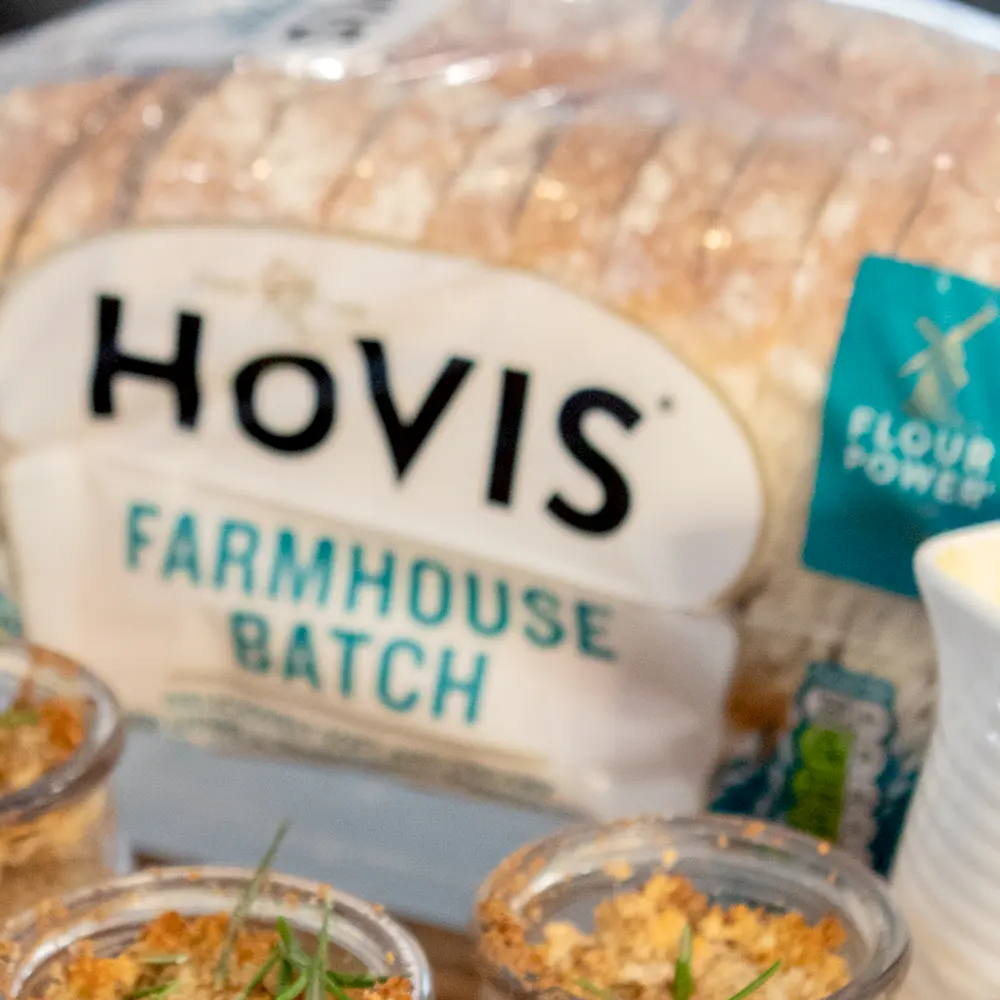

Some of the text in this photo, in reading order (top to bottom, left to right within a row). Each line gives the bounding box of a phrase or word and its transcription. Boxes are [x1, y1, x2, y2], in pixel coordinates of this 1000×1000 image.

[844, 444, 988, 508] POWER
[847, 405, 995, 472] FLOUR
[125, 503, 618, 660] FARMHOUSE
[231, 613, 489, 725] BATCH
